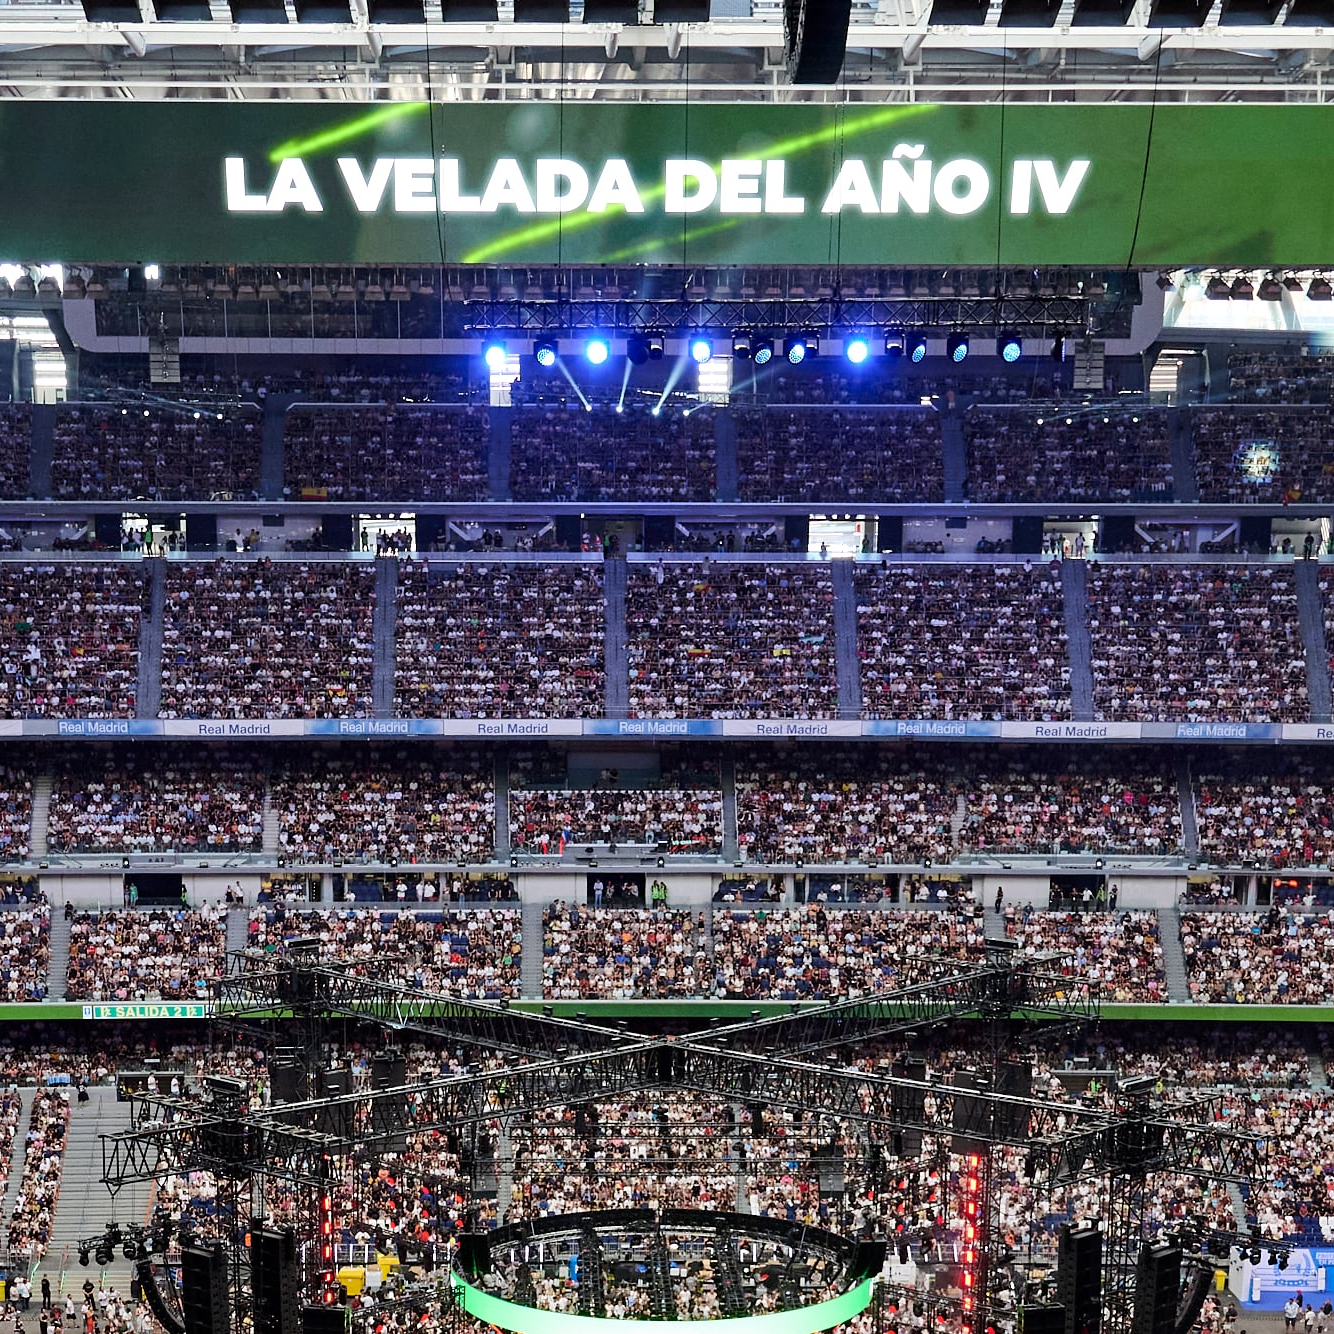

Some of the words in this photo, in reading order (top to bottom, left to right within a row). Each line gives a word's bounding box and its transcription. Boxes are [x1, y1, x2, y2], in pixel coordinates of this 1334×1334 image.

[225, 156, 324, 212] LA
[337, 157, 645, 213] VELADA
[664, 158, 805, 213] DEL
[821, 143, 990, 214] AÑO
[1010, 159, 1090, 213] IV
[58, 721, 85, 733] Real
[88, 721, 128, 733] Madrid
[199, 724, 225, 735] Real
[229, 723, 270, 735] Madrid
[340, 721, 365, 733] Real
[368, 721, 408, 733] Madrid
[478, 723, 503, 734] Real
[507, 723, 548, 734] Madrid
[619, 721, 644, 733] Real
[647, 721, 687, 733] Madrid
[757, 724, 783, 735] Real
[787, 724, 828, 735] Madrid
[897, 722, 923, 734] Real
[927, 722, 966, 734] Madrid
[1035, 726, 1062, 737] Real
[1066, 725, 1107, 737] Madrid
[1177, 725, 1203, 736] Real
[1207, 725, 1247, 736] Madrid
[116, 1005, 170, 1017] SALIDA
[173, 1005, 182, 1017] 2
